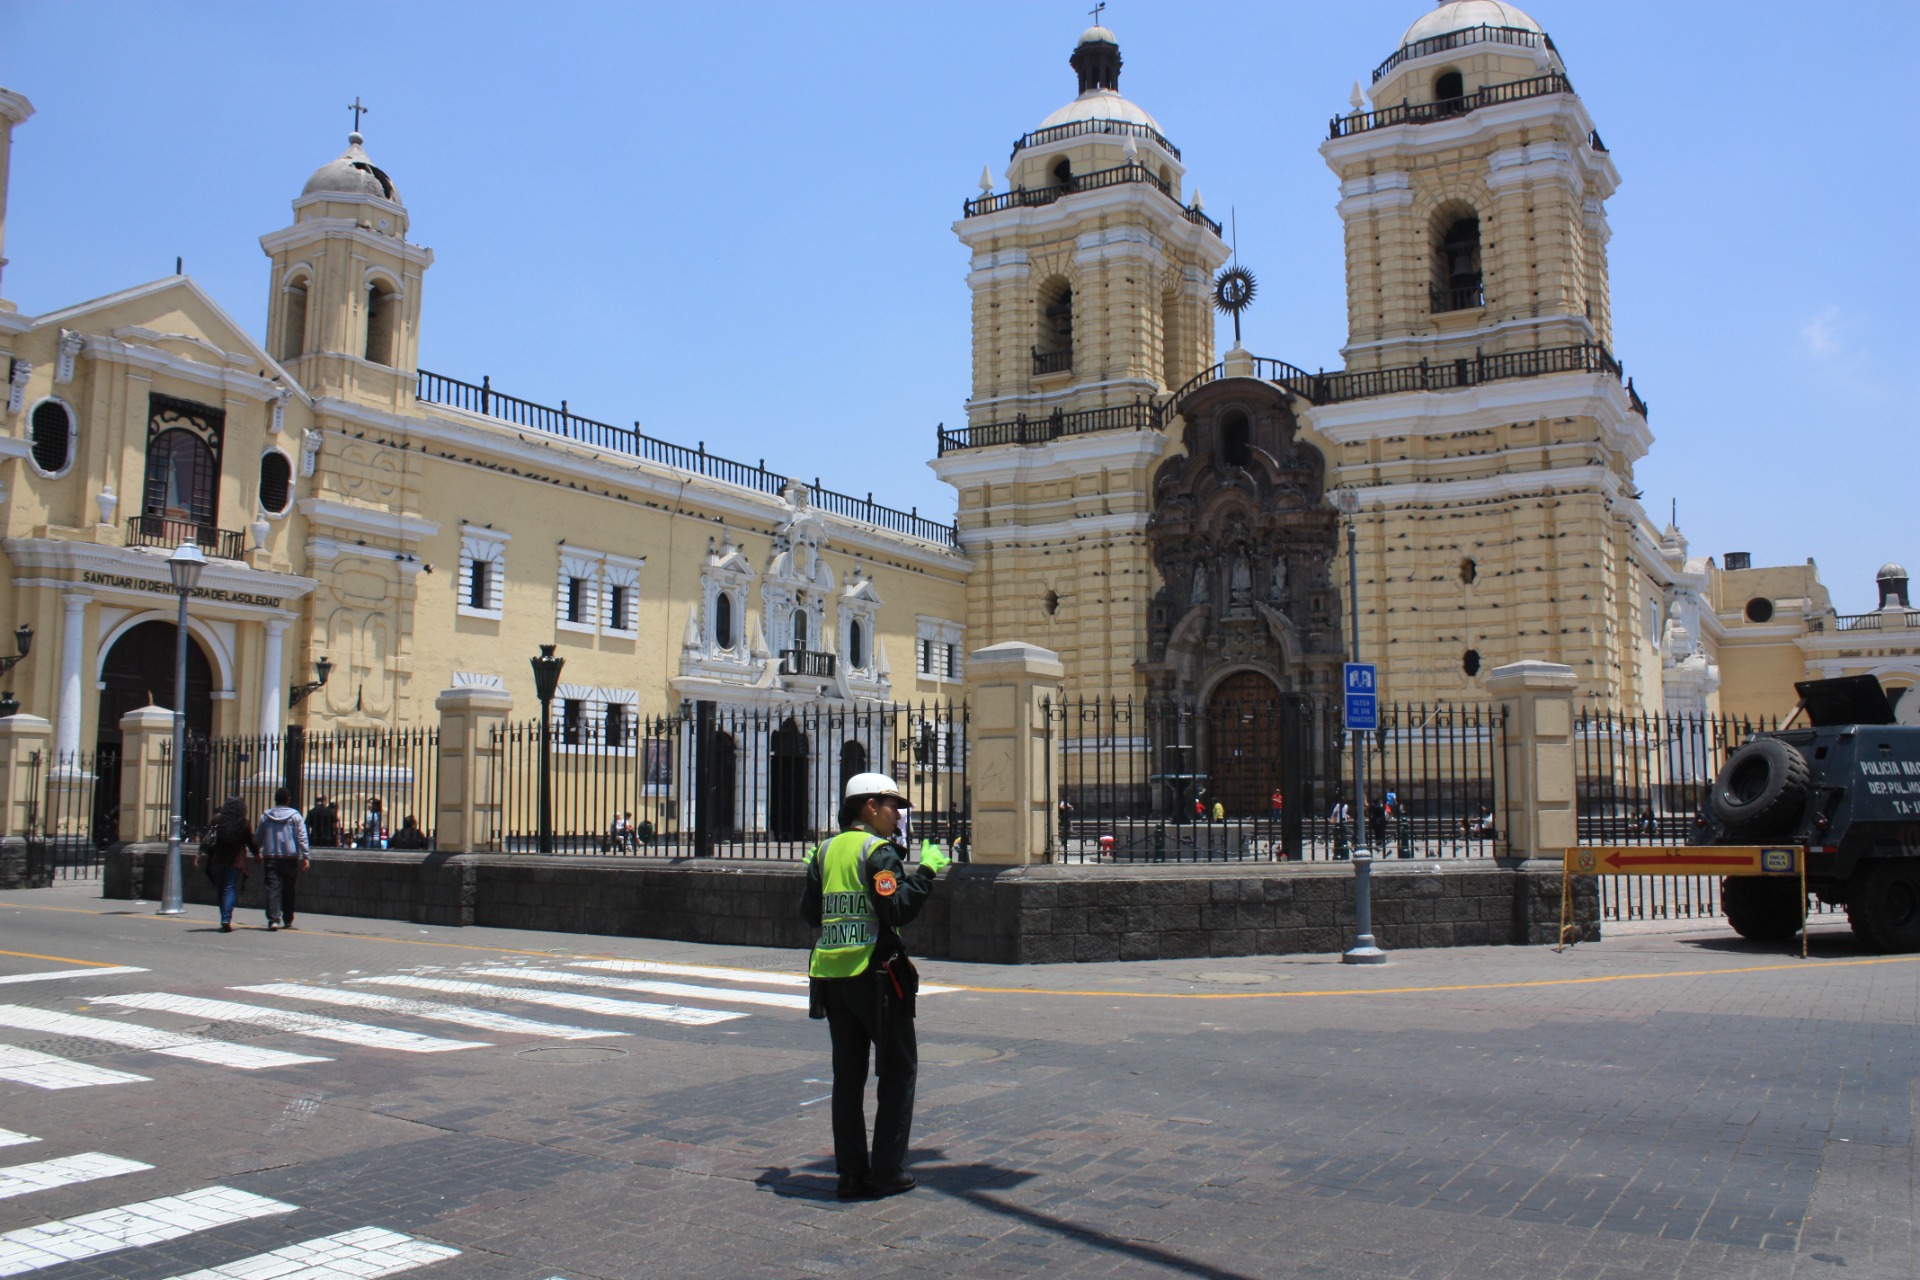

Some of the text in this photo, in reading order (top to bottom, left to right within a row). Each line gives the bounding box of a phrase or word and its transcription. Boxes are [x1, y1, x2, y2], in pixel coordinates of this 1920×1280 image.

[83, 571, 147, 590] SANTUARIO
[148, 580, 162, 592] DE
[211, 590, 225, 601] DE
[237, 593, 280, 608] SOLEDAD
[1860, 761, 1900, 776] POLICIA
